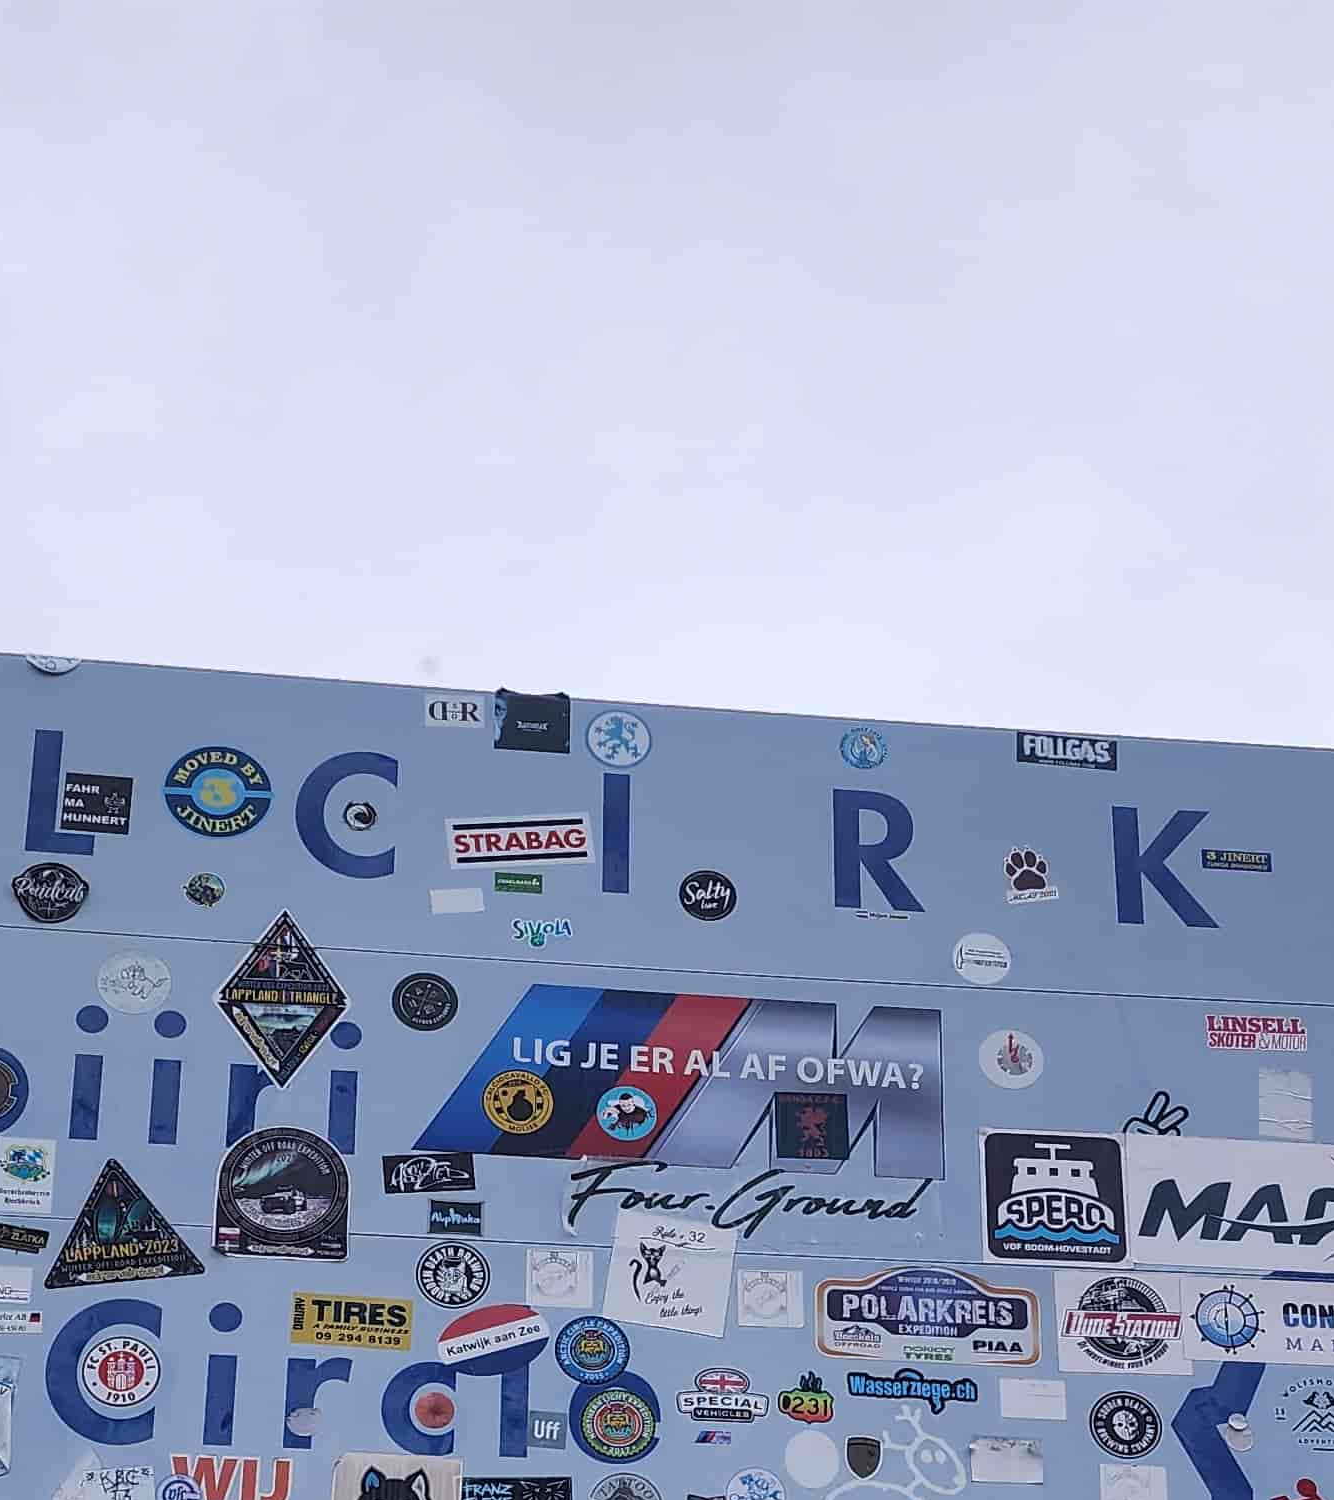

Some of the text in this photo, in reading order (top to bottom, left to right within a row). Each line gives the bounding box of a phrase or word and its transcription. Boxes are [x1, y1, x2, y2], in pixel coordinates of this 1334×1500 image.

[453, 829, 586, 854] STRABAG
[1208, 1016, 1306, 1034] LINSELL
[1208, 1032, 1306, 1050] SKOTER & MOTOR
[512, 1036, 924, 1089] LIG JE ER AL AF OFWA?
[1007, 1200, 1101, 1228] SPERO
[1003, 1243, 1112, 1255] VOF BOOM-HOVESTADT
[313, 1300, 408, 1326] TIRES
[316, 1332, 401, 1345] 09 294 8139
[446, 1325, 540, 1358] Katwijk aan Zee
[973, 1340, 1023, 1352] PIAA
[849, 1374, 975, 1399] Wasserziege.ch
[106, 1391, 135, 1403] 1910
[685, 1395, 761, 1410] SPECIAL
[533, 1419, 560, 1439] Uff
